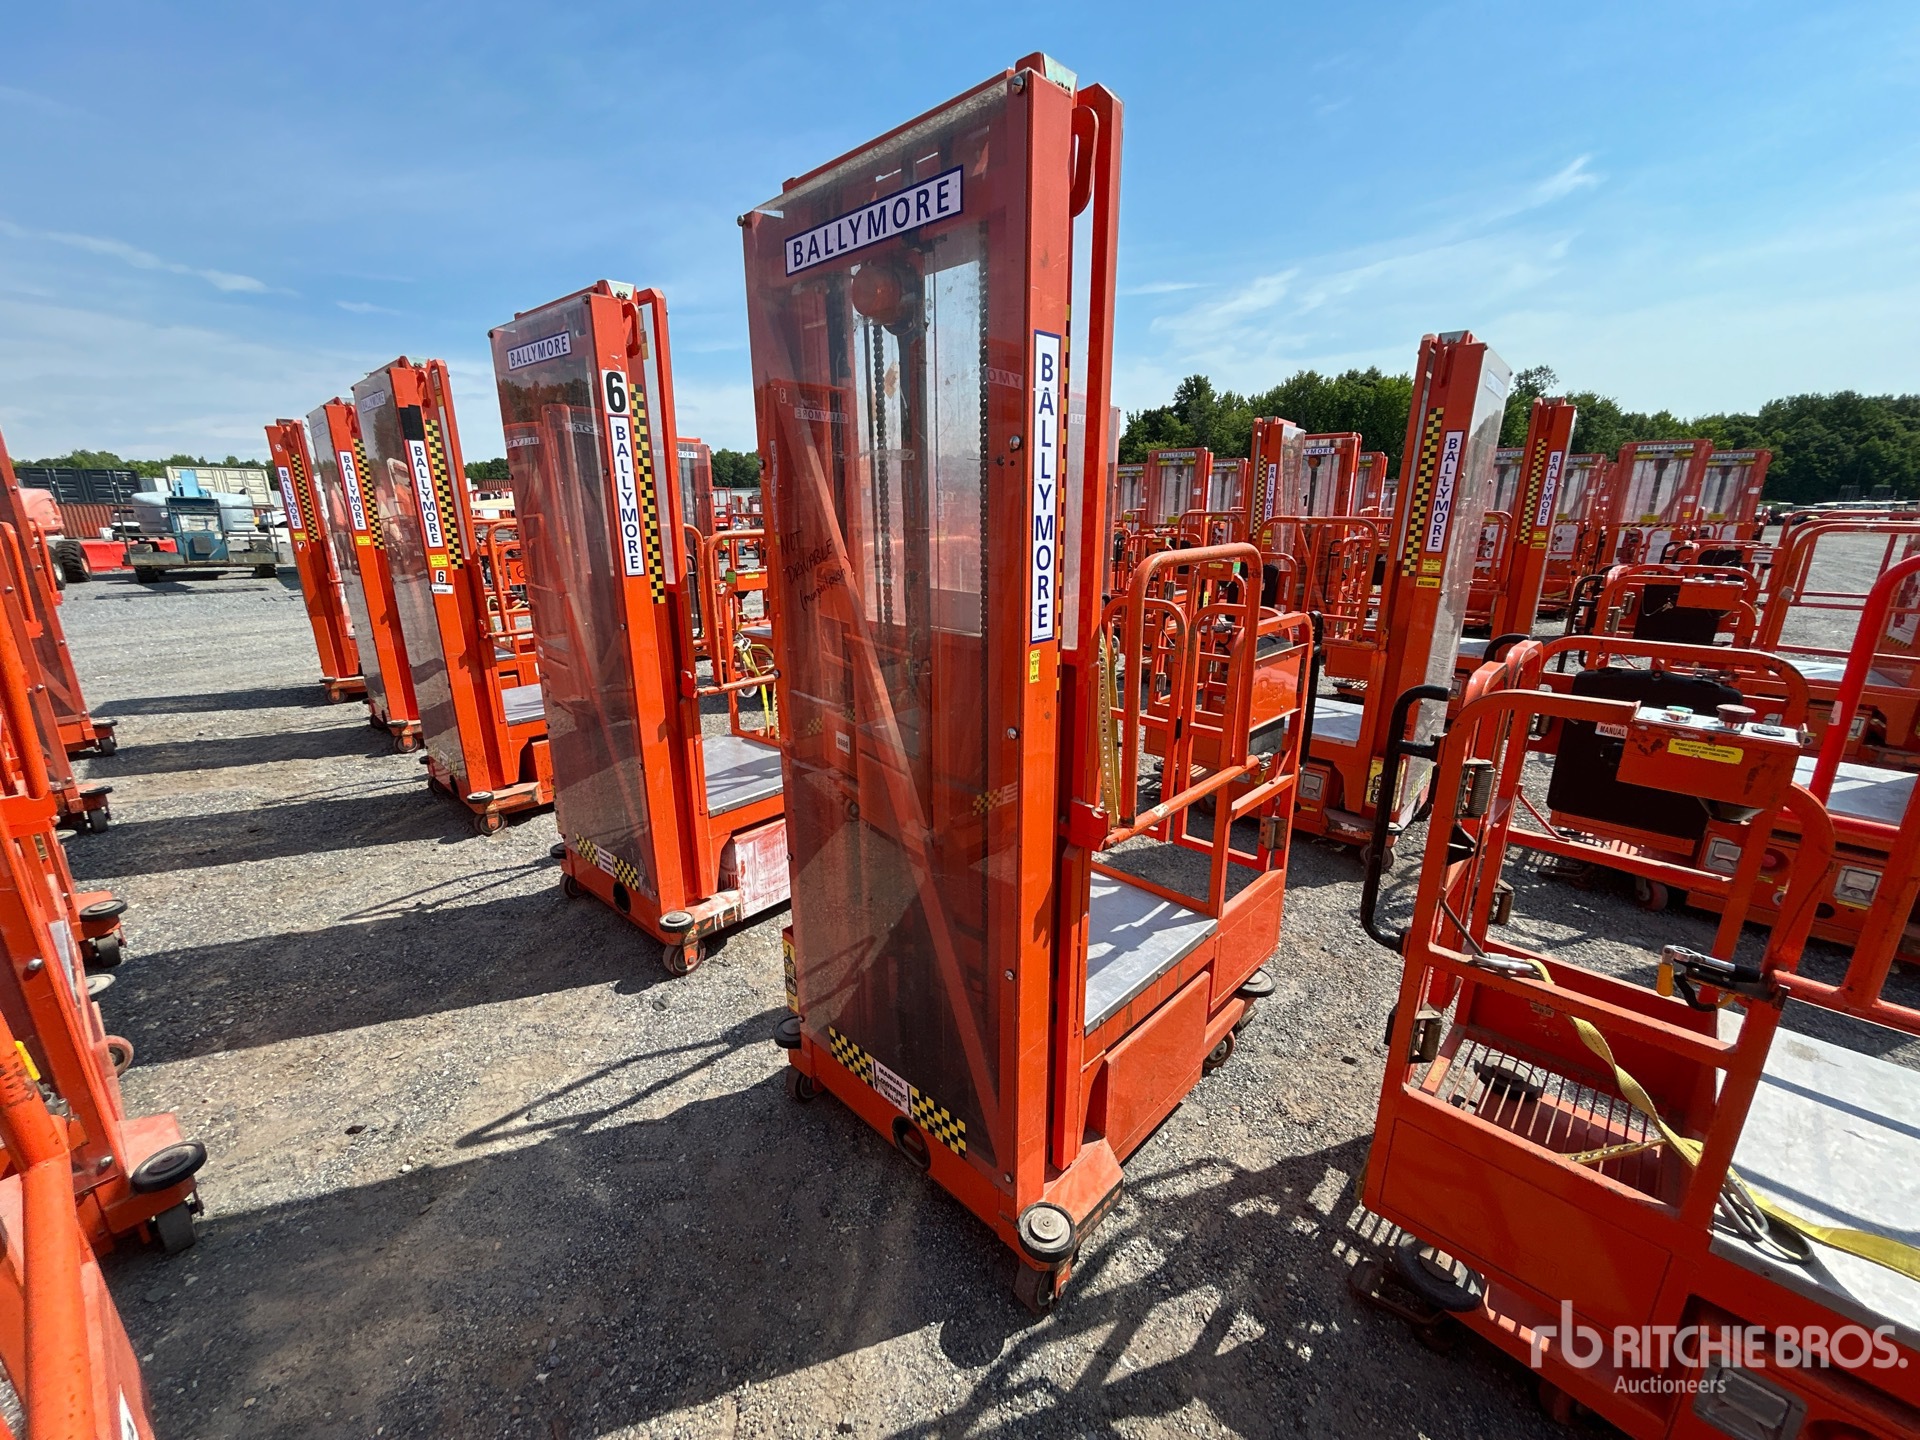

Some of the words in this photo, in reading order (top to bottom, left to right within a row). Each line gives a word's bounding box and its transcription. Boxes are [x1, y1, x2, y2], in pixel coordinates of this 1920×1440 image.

[793, 178, 951, 268] BALLYMORE
[510, 334, 569, 368] BALLYMORE
[606, 372, 627, 414] 6
[281, 469, 300, 527] BALLYMORE
[344, 456, 364, 530] BALLYMORE
[414, 446, 439, 544] BALLYMORE
[614, 425, 640, 569] BALLYMORE
[1035, 353, 1055, 629] BALLYMORE
[1431, 438, 1458, 548] BALLYMORE
[1540, 455, 1559, 523] BALLYMORE
[781, 530, 802, 557] NOT
[438, 571, 444, 582] 6
[877, 1075, 907, 1101] LOWERING
[878, 1067, 904, 1090] MANUAL
